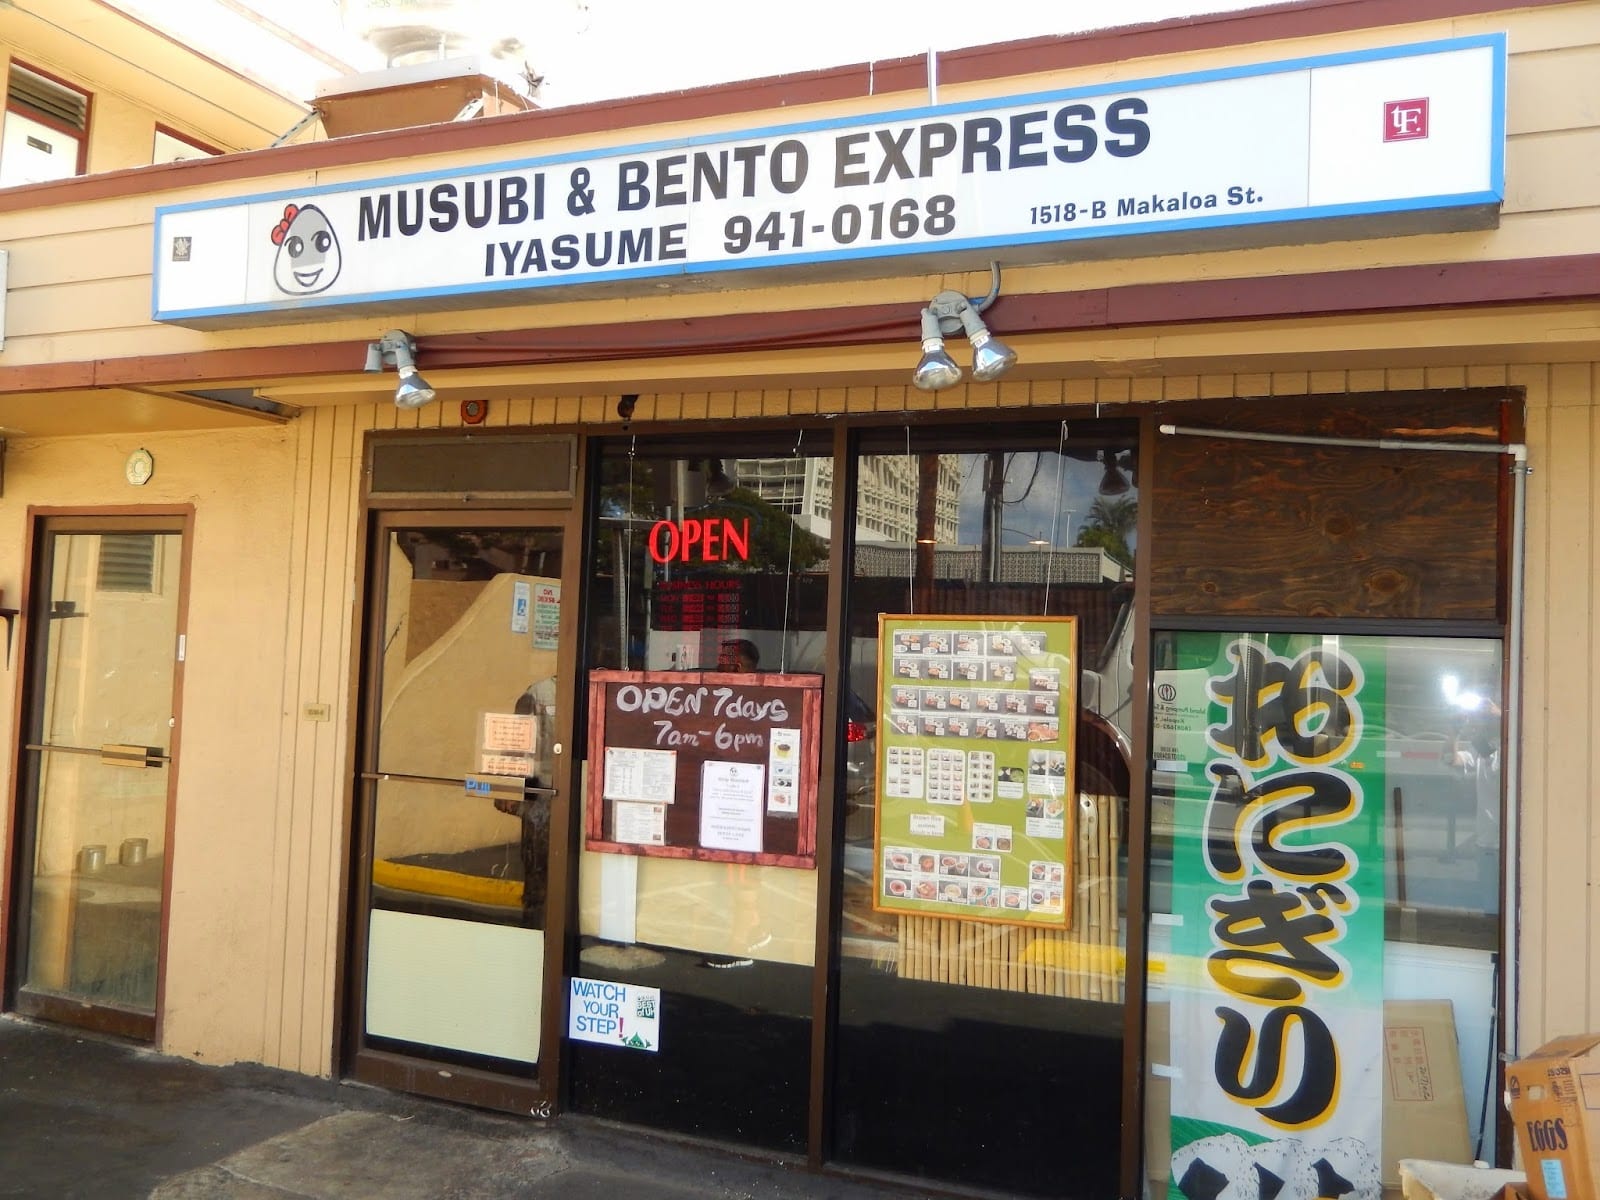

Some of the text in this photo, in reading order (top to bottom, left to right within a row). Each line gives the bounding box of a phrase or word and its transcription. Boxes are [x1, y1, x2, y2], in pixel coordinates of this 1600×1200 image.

[358, 97, 1151, 242] MUSUBI & BENTO EXPRESS
[1030, 186, 1264, 226] 1518-B Makaloa St.
[485, 194, 957, 277] IYASUME 941-0168
[648, 518, 749, 564] OPEN
[616, 685, 708, 717] OPEN
[1204, 641, 1362, 1132] おにぎり
[573, 980, 626, 1003] WATCH
[583, 1000, 620, 1019] YOUR
[1526, 1117, 1569, 1152] EGGS
